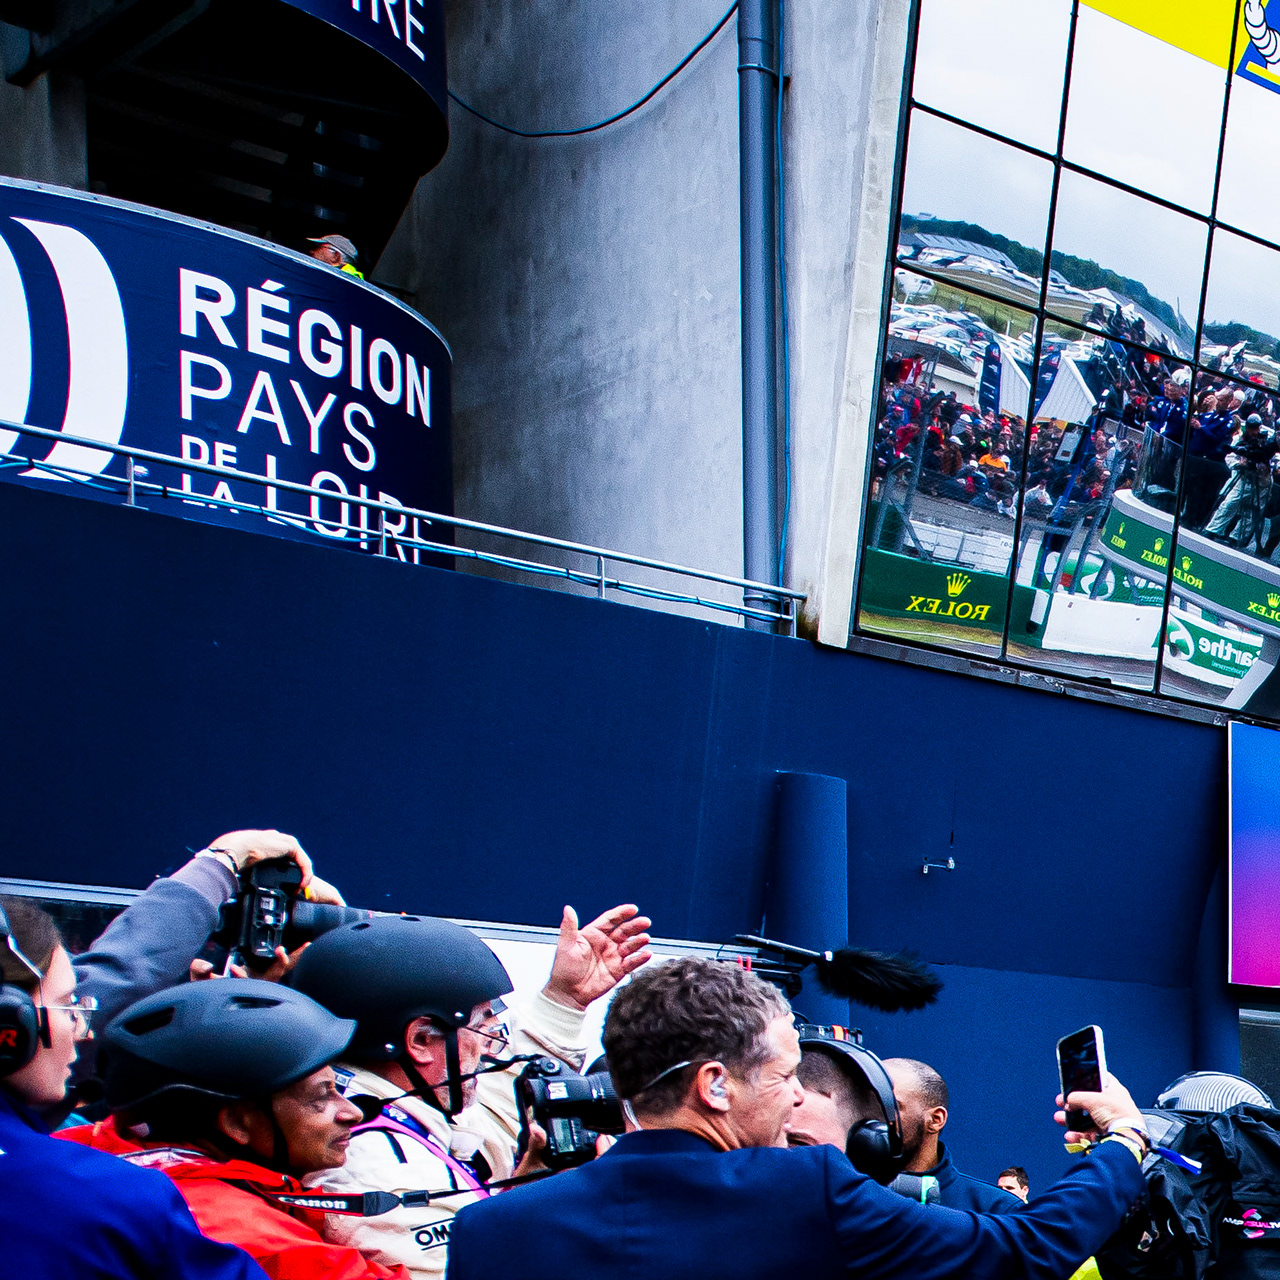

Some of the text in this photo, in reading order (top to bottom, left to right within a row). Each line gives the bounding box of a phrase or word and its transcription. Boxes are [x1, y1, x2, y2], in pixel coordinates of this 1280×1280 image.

[179, 267, 431, 428] RÉGION
[180, 350, 377, 471] PAYS
[181, 434, 237, 471] DE
[278, 1196, 347, 1210] Canon
[415, 1221, 451, 1247] OM
